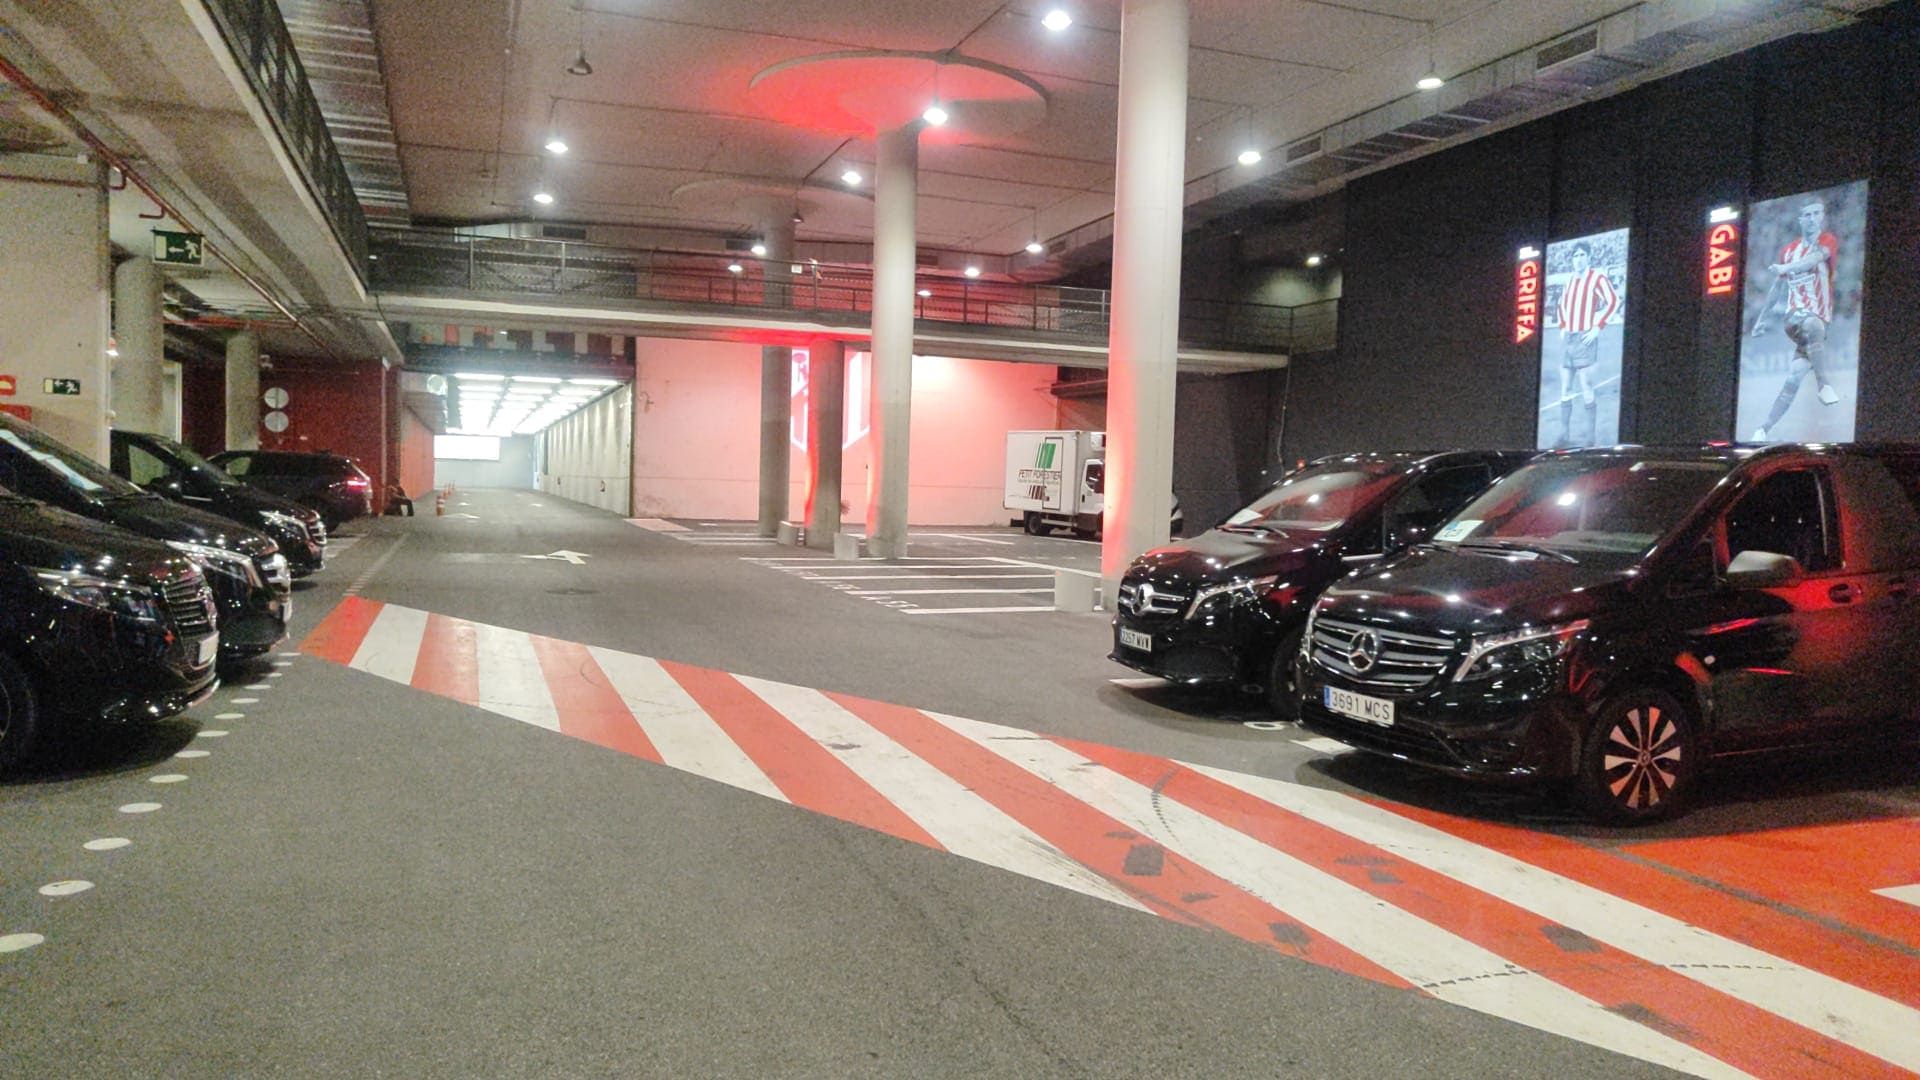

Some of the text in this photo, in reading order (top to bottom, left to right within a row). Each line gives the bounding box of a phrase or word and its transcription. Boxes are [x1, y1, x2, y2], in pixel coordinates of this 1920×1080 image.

[1708, 224, 1735, 293] GABI
[1516, 260, 1537, 342] GRIFFA
[1332, 691, 1390, 720] 3691 MCS
